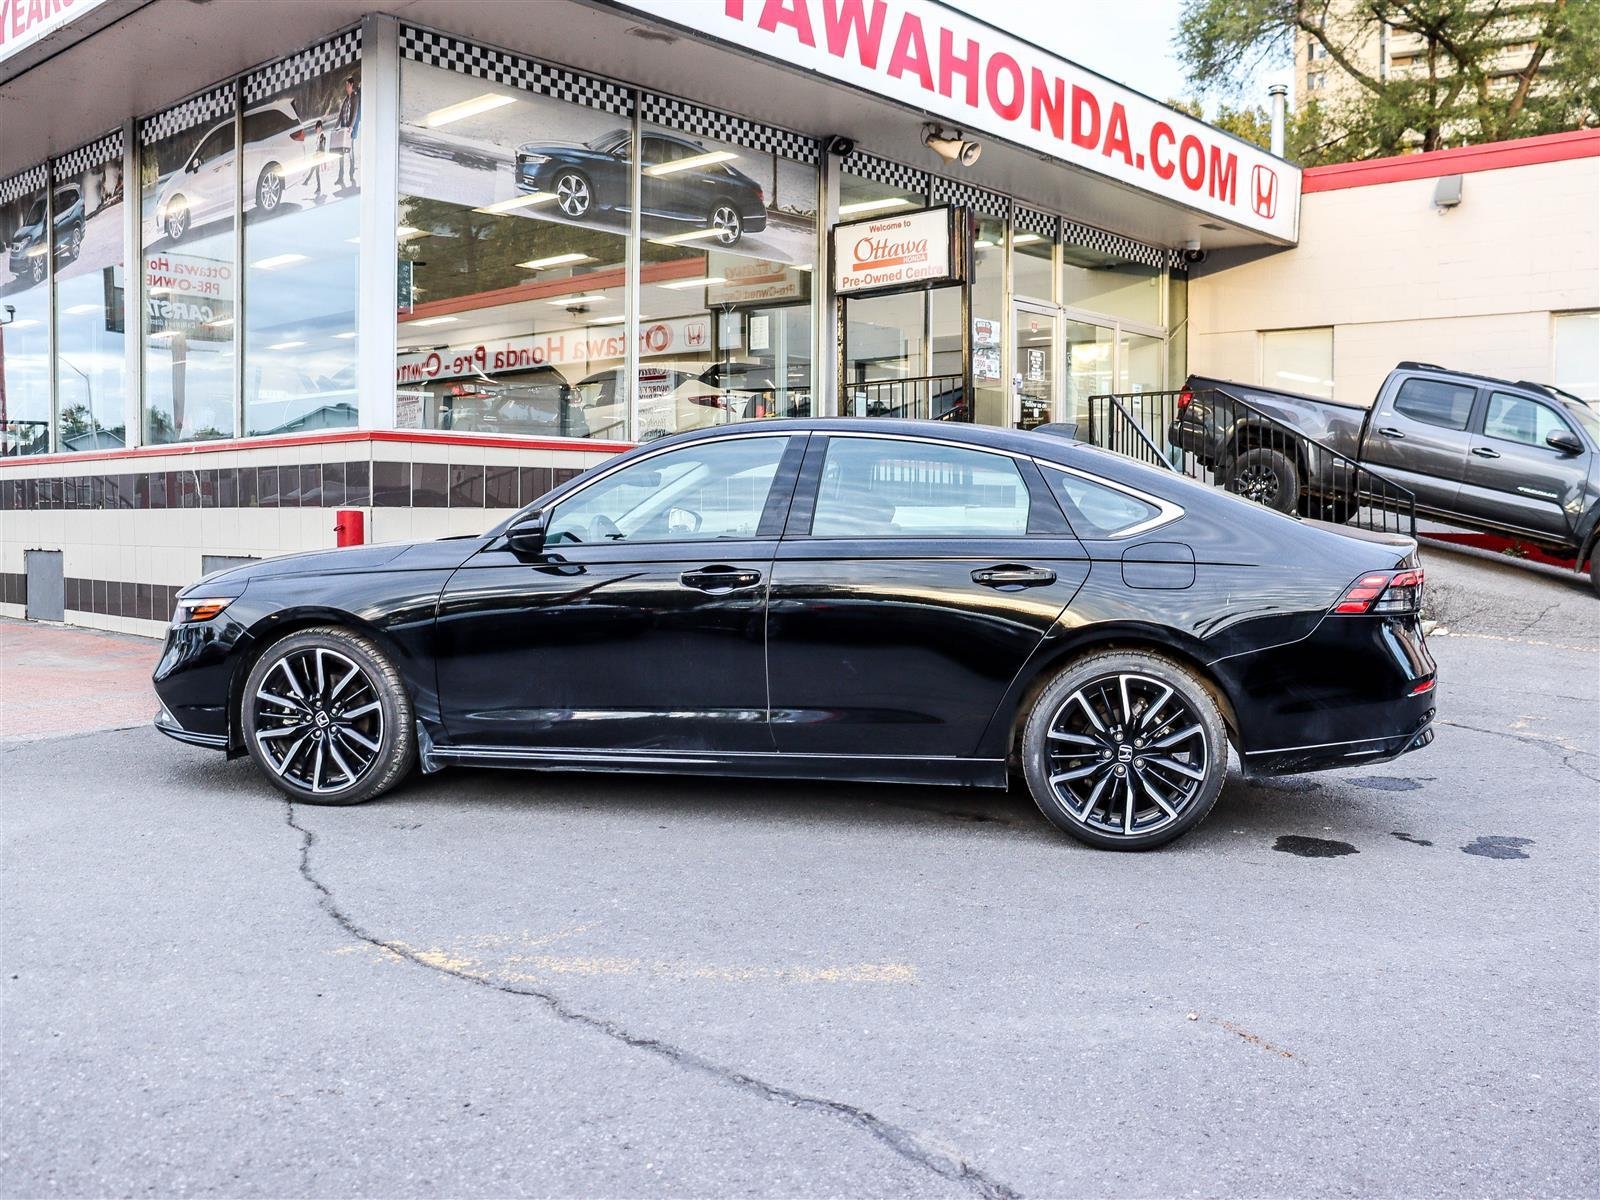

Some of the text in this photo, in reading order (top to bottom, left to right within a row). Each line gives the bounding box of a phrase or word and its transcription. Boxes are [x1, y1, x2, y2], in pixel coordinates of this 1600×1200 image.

[0, 0, 74, 45] YEA
[725, 0, 1238, 207] AWAHONDA.COM
[869, 220, 911, 233] Welcome to
[853, 237, 928, 262] Ottawa
[842, 265, 944, 287] Pre-Owned Centre
